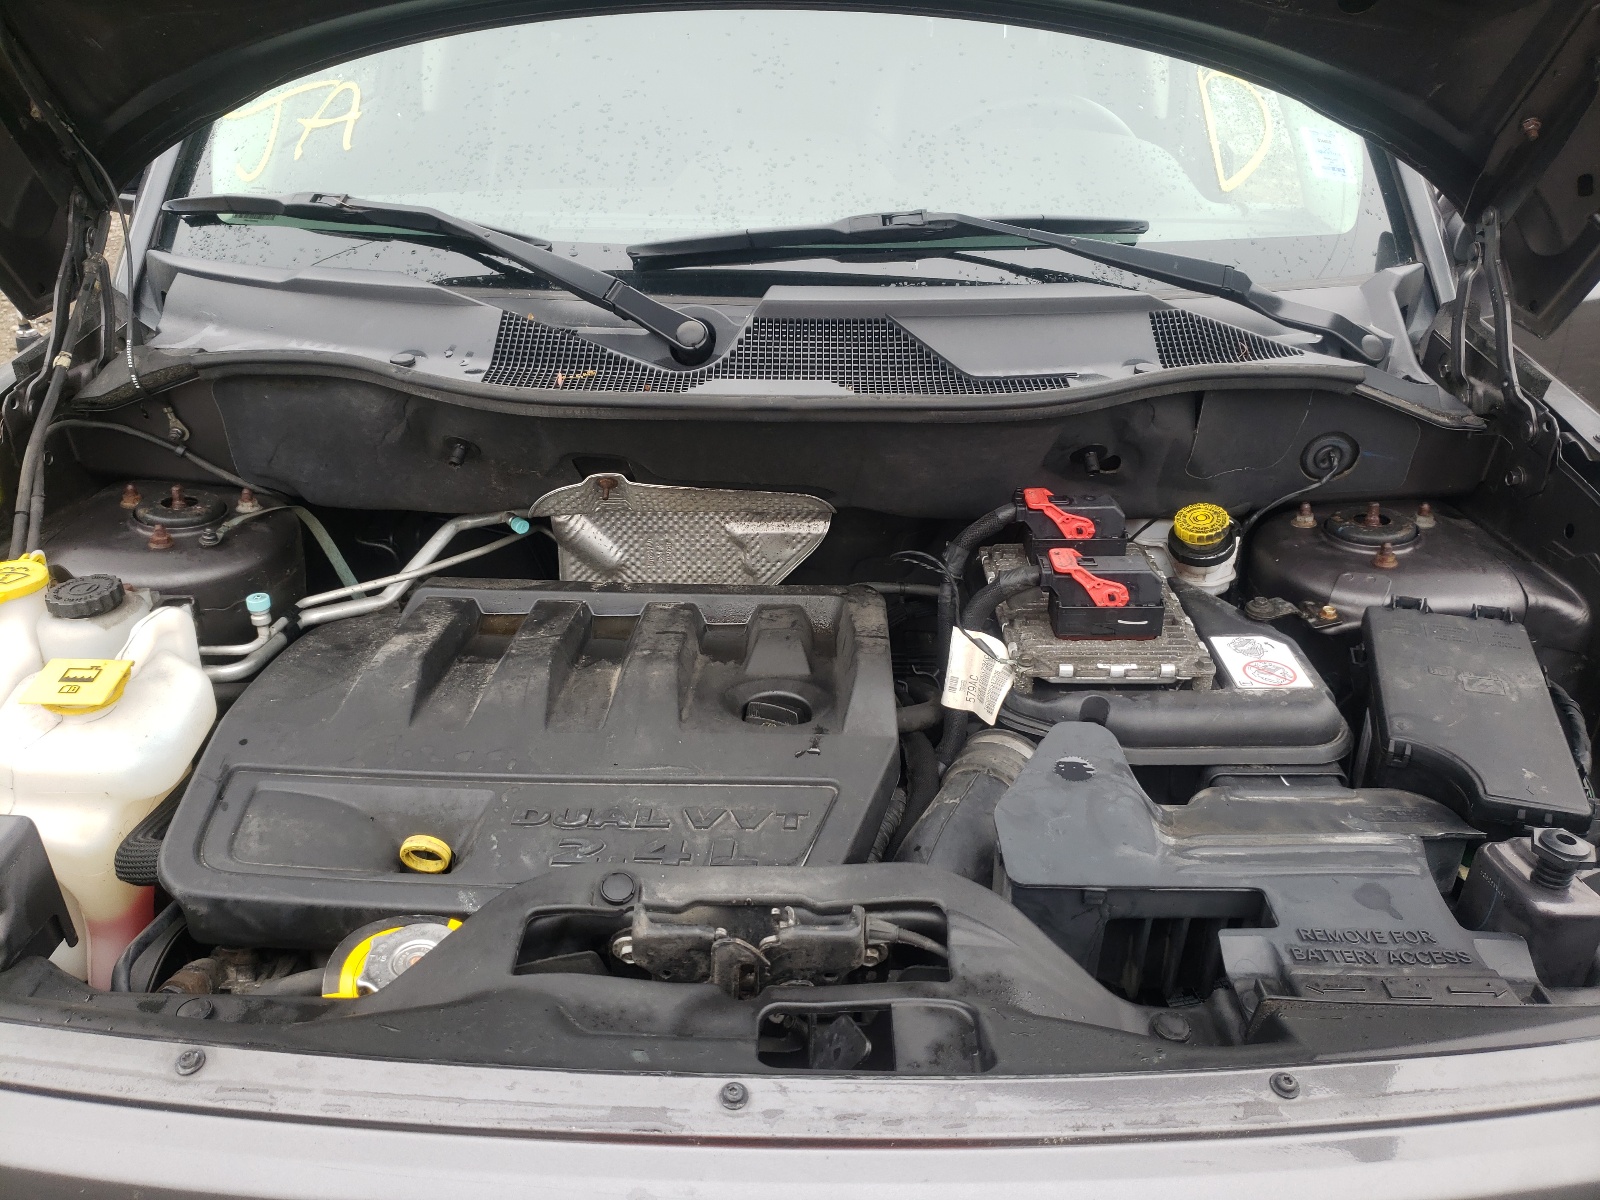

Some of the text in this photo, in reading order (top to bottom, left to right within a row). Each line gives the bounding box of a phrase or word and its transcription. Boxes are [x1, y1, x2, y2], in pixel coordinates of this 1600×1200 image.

[965, 674, 979, 704] 579AC
[511, 807, 811, 830] DUAL VVT
[1295, 928, 1437, 945] REMOVE FOR
[1290, 948, 1473, 965] BATTERY ACCESS
